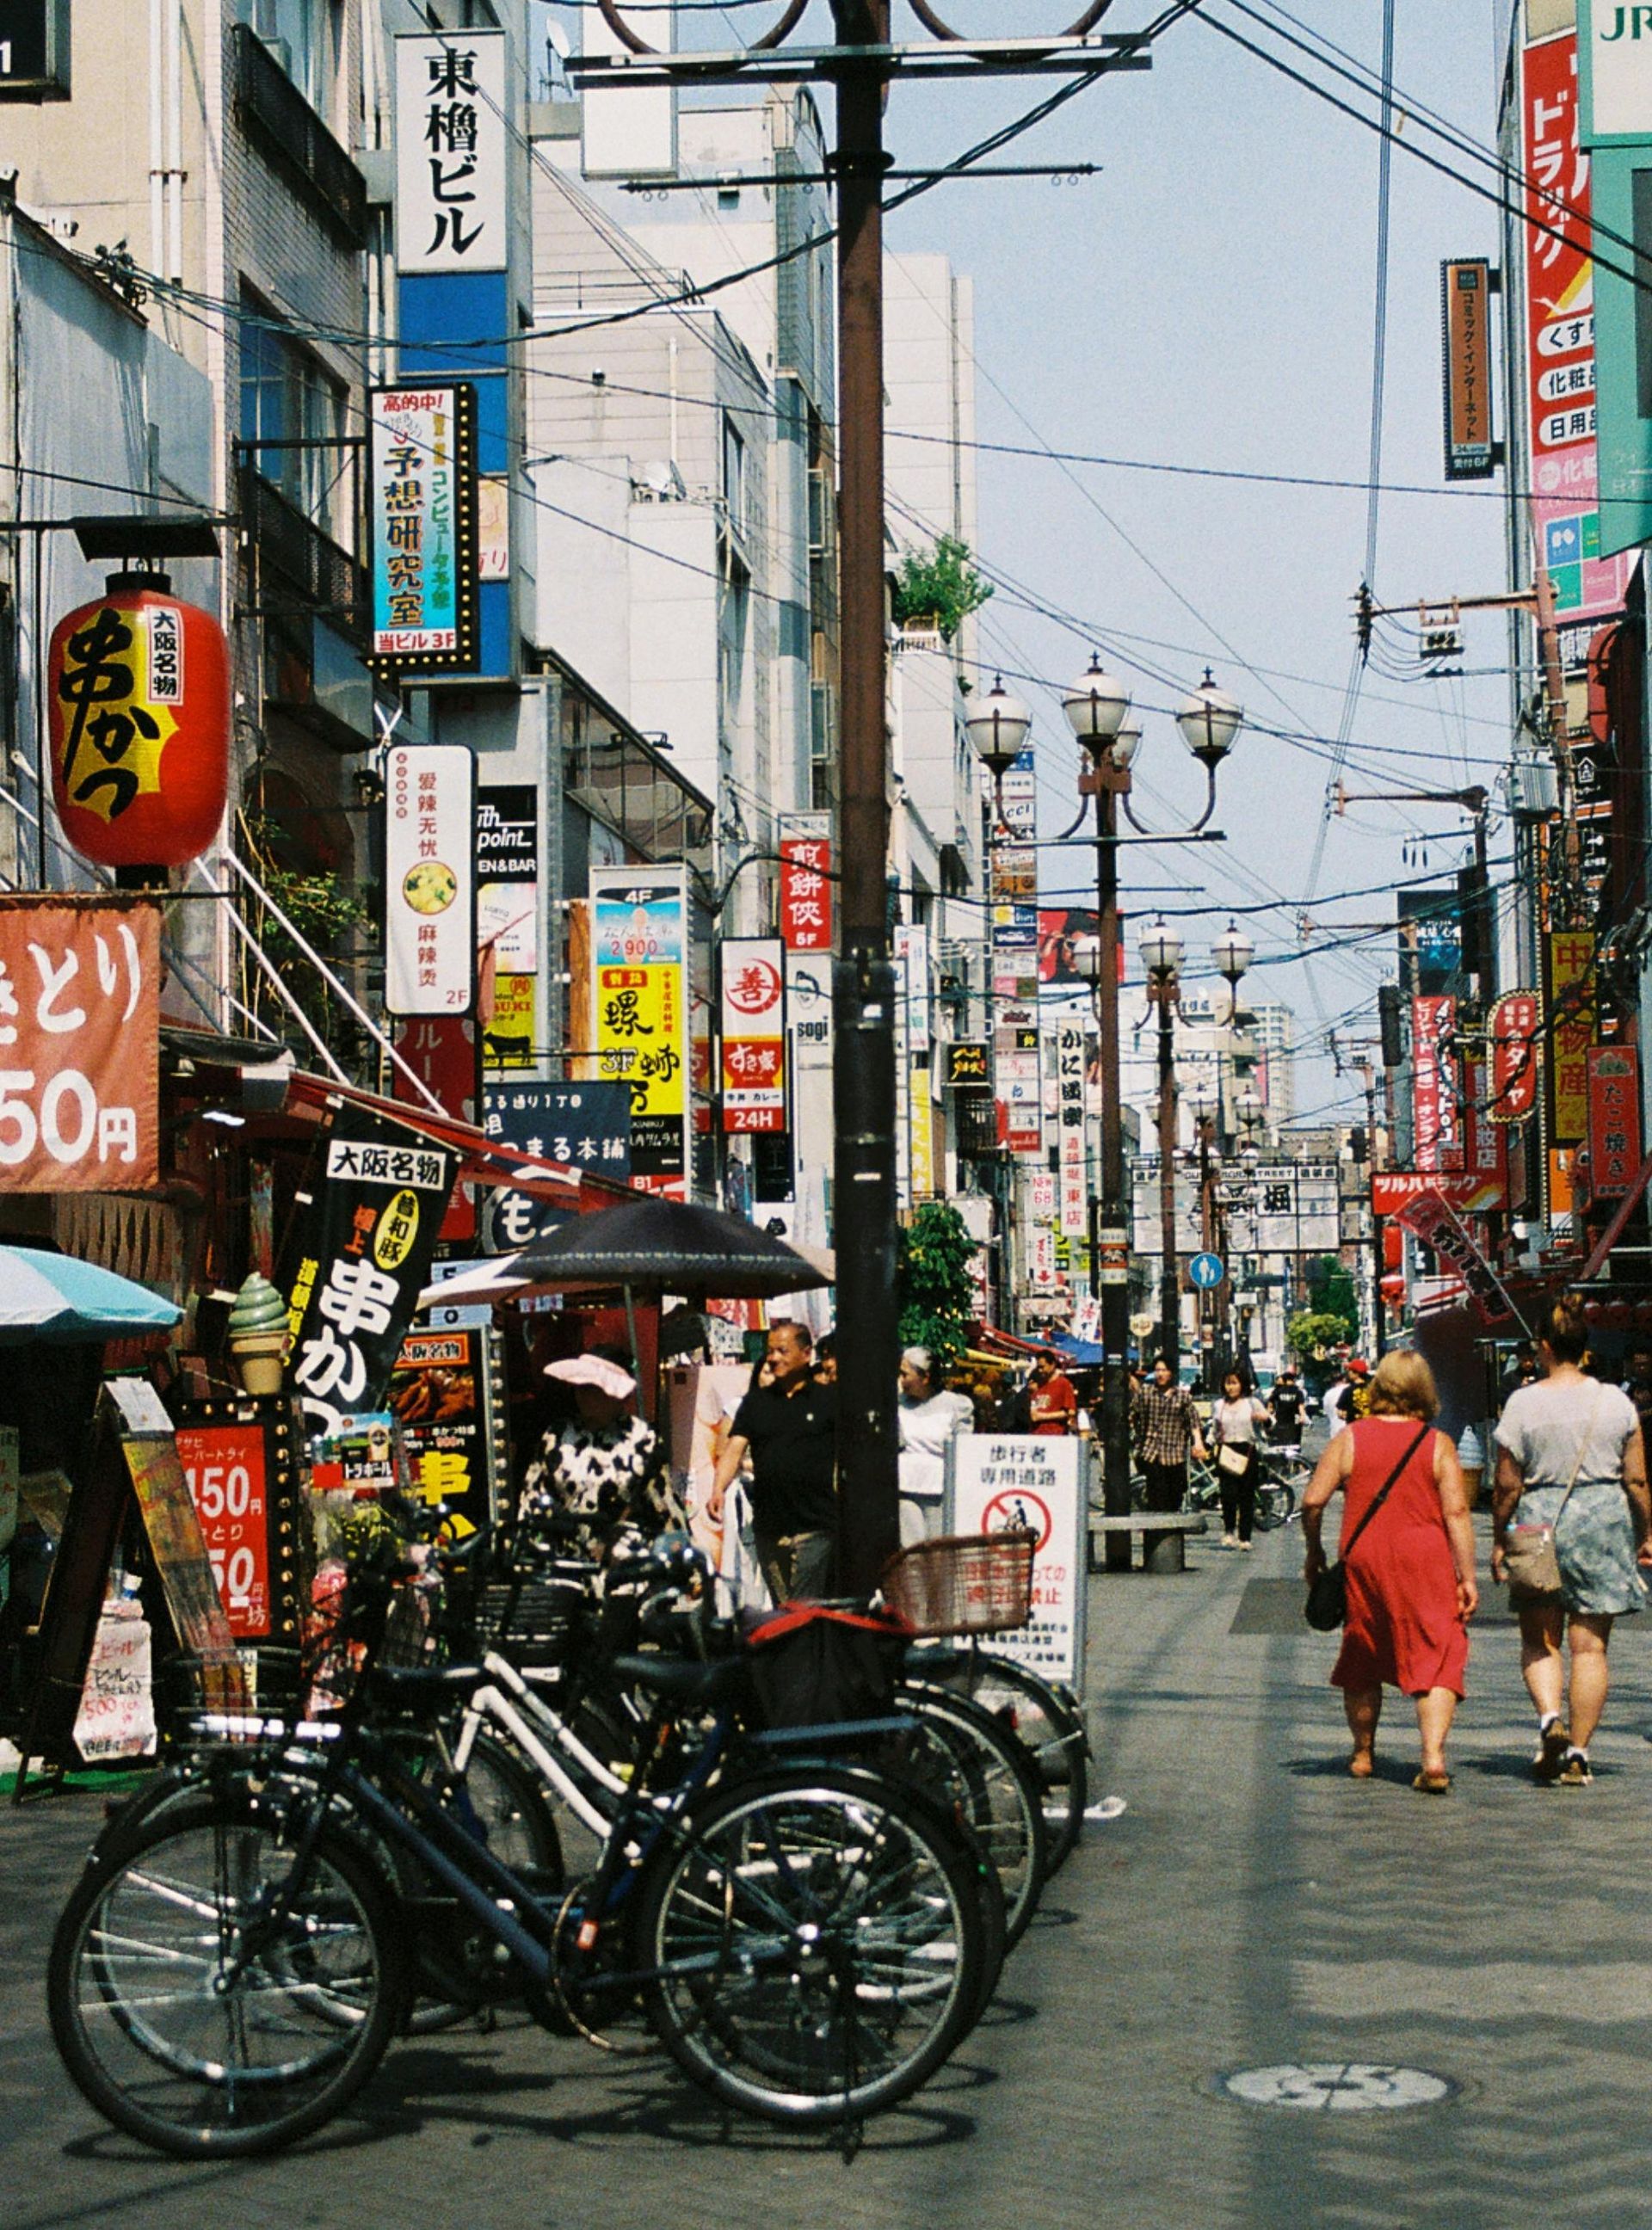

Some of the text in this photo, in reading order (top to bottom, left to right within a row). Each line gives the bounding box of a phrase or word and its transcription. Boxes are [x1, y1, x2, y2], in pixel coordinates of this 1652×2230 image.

[424, 48, 484, 256] 東櫓ビル
[384, 447, 423, 627] 予想研究室
[432, 632, 454, 649] 3F
[153, 611, 177, 696] 大阪名物
[59, 607, 161, 817] 串かつ
[478, 828, 533, 853] point
[626, 890, 653, 904] 4F
[446, 990, 467, 1004] 2F
[797, 1016, 828, 1042] sogi
[733, 1111, 774, 1129] 24H
[332, 1146, 441, 1186] 大阪名物
[990, 1445, 1047, 1463] 歩行者
[981, 1468, 1056, 1486] 専用道路
